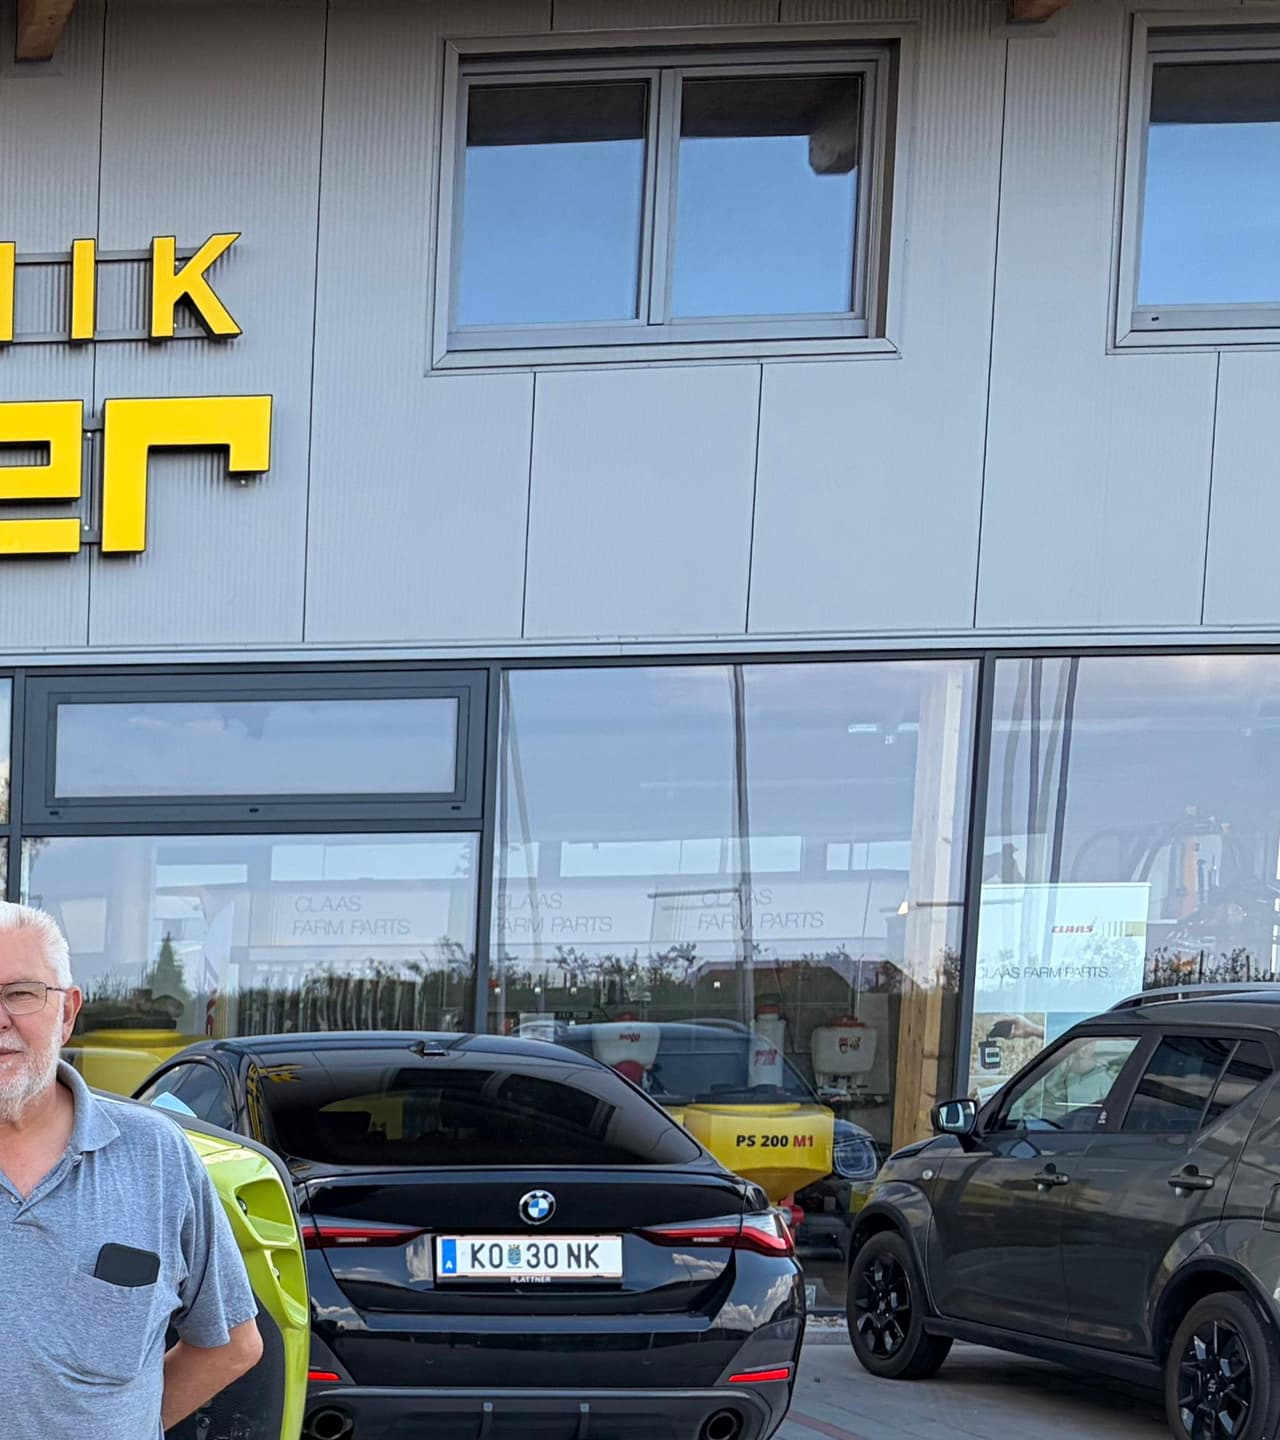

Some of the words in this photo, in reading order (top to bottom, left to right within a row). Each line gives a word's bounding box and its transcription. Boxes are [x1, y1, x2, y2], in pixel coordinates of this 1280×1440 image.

[295, 895, 362, 912] CLAAS
[292, 919, 344, 936] FARM
[350, 918, 412, 936] PARTS
[551, 915, 614, 933] PARTS
[760, 911, 825, 929] PARTS
[1050, 923, 1095, 935] CLAAS
[1023, 966, 1062, 979] FARM
[735, 1134, 757, 1148] PS
[760, 1134, 789, 1148] 200
[792, 1134, 815, 1148] M1
[470, 1242, 504, 1269] KO
[526, 1242, 559, 1269] 30
[567, 1242, 601, 1269] NK
[510, 1276, 552, 1284] PLATTNER
